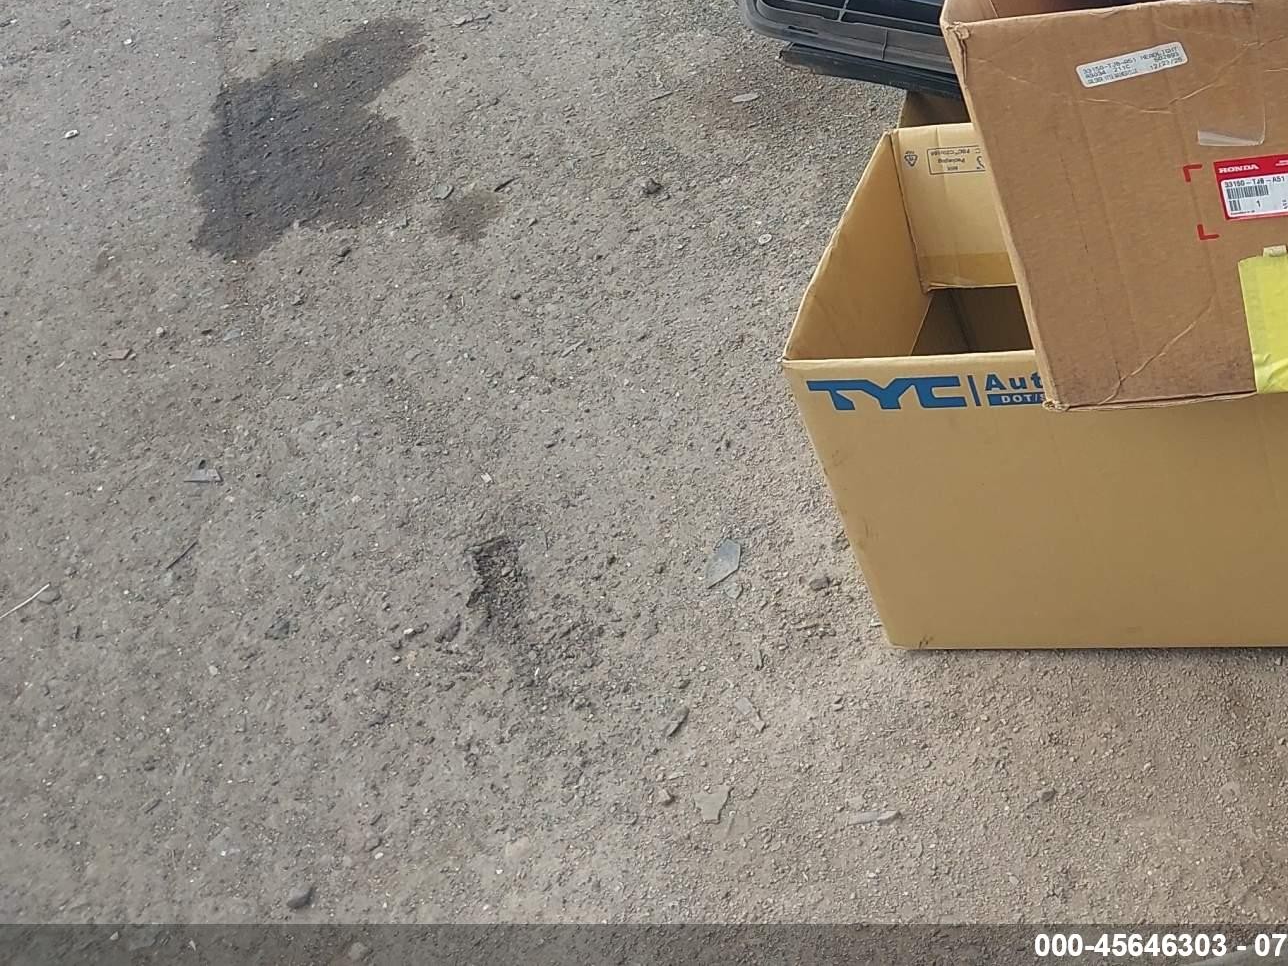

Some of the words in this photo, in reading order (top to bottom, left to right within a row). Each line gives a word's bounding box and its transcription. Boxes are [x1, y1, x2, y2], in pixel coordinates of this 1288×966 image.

[1218, 163, 1260, 174] HONDA
[806, 376, 967, 410] TYC
[985, 372, 1044, 390] Aut
